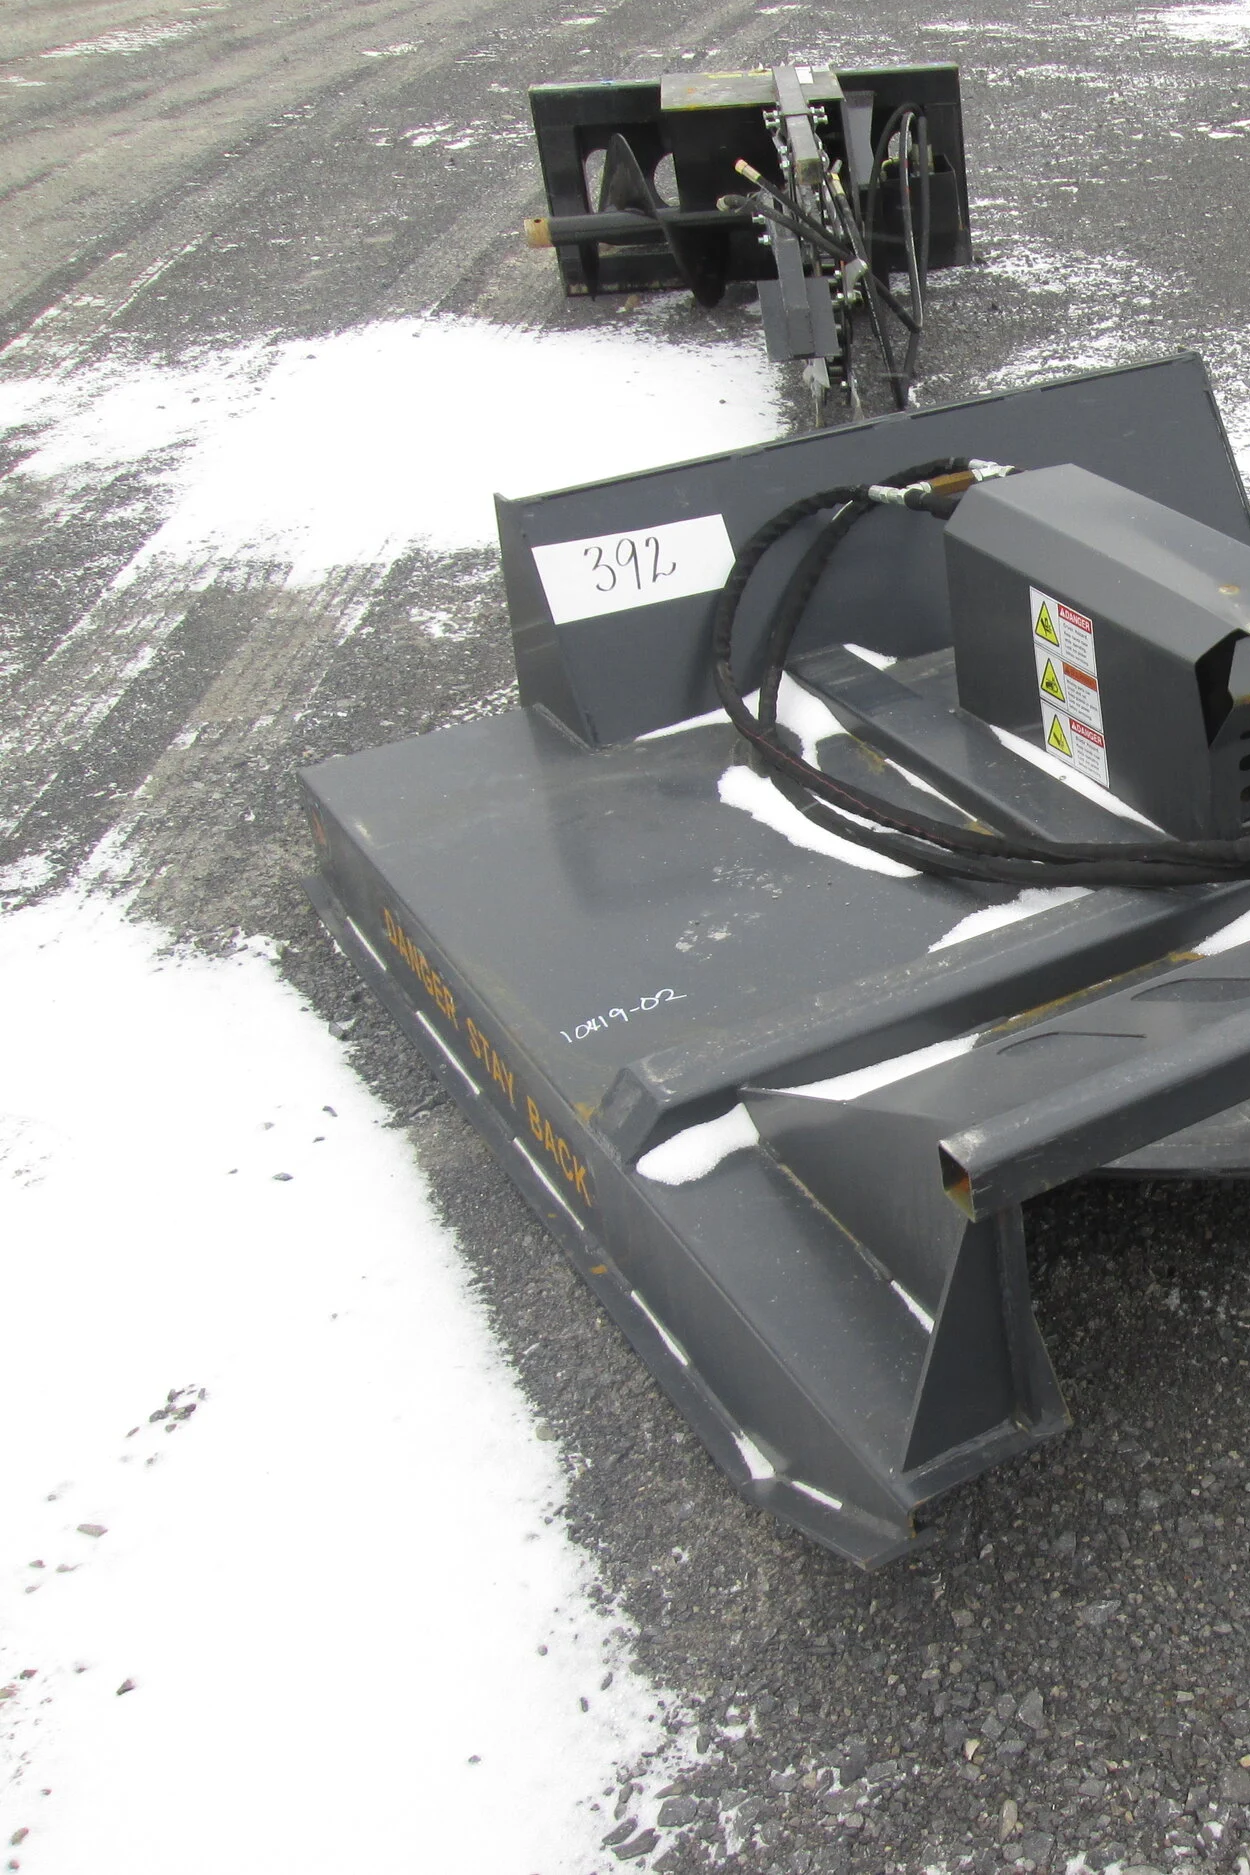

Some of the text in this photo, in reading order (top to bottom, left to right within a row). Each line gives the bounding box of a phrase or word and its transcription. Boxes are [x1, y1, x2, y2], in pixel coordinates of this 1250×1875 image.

[584, 536, 677, 592] 392
[1065, 609, 1091, 631] DANGER
[1076, 723, 1103, 746] DANGER
[560, 988, 688, 1043] 10419-02
[467, 1018, 516, 1106] STAY
[527, 1096, 592, 1208] BACK
